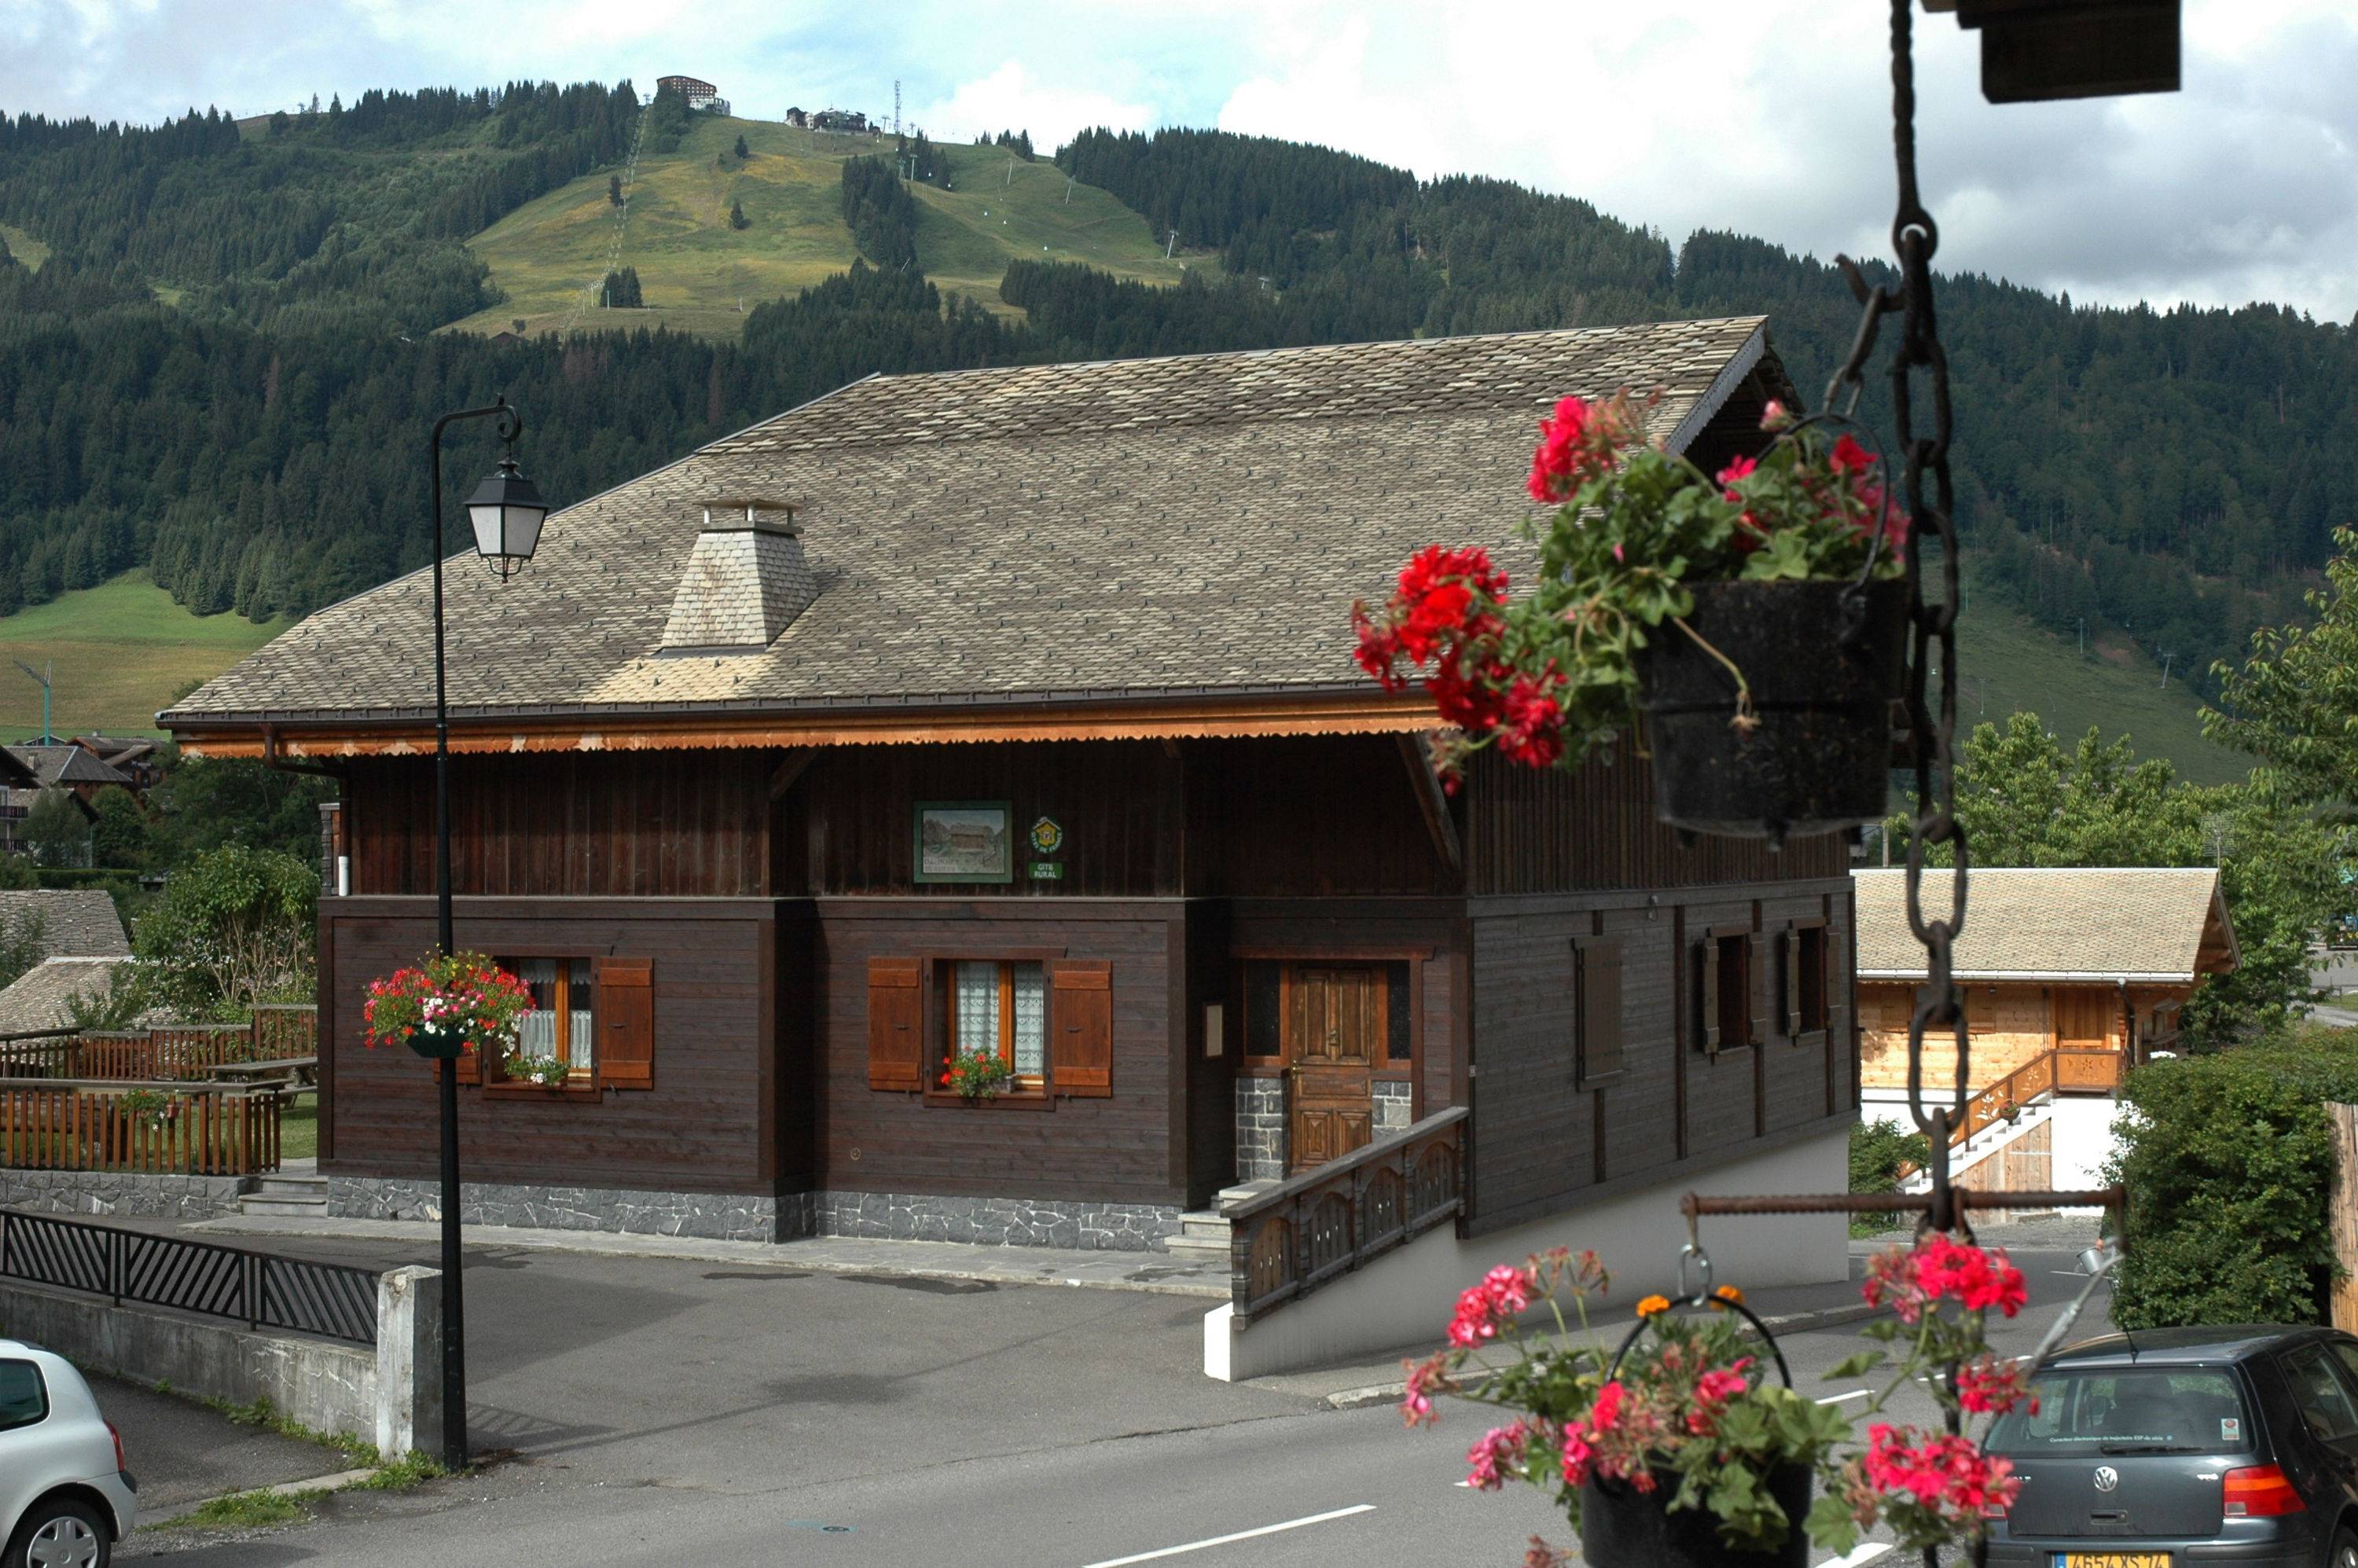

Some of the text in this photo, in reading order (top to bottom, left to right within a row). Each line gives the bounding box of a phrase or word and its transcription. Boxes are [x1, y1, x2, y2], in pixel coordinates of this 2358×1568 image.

[1034, 870, 1057, 879] RURAL
[2121, 1554, 2139, 1568] XS
[2143, 1554, 2163, 1568] 74
